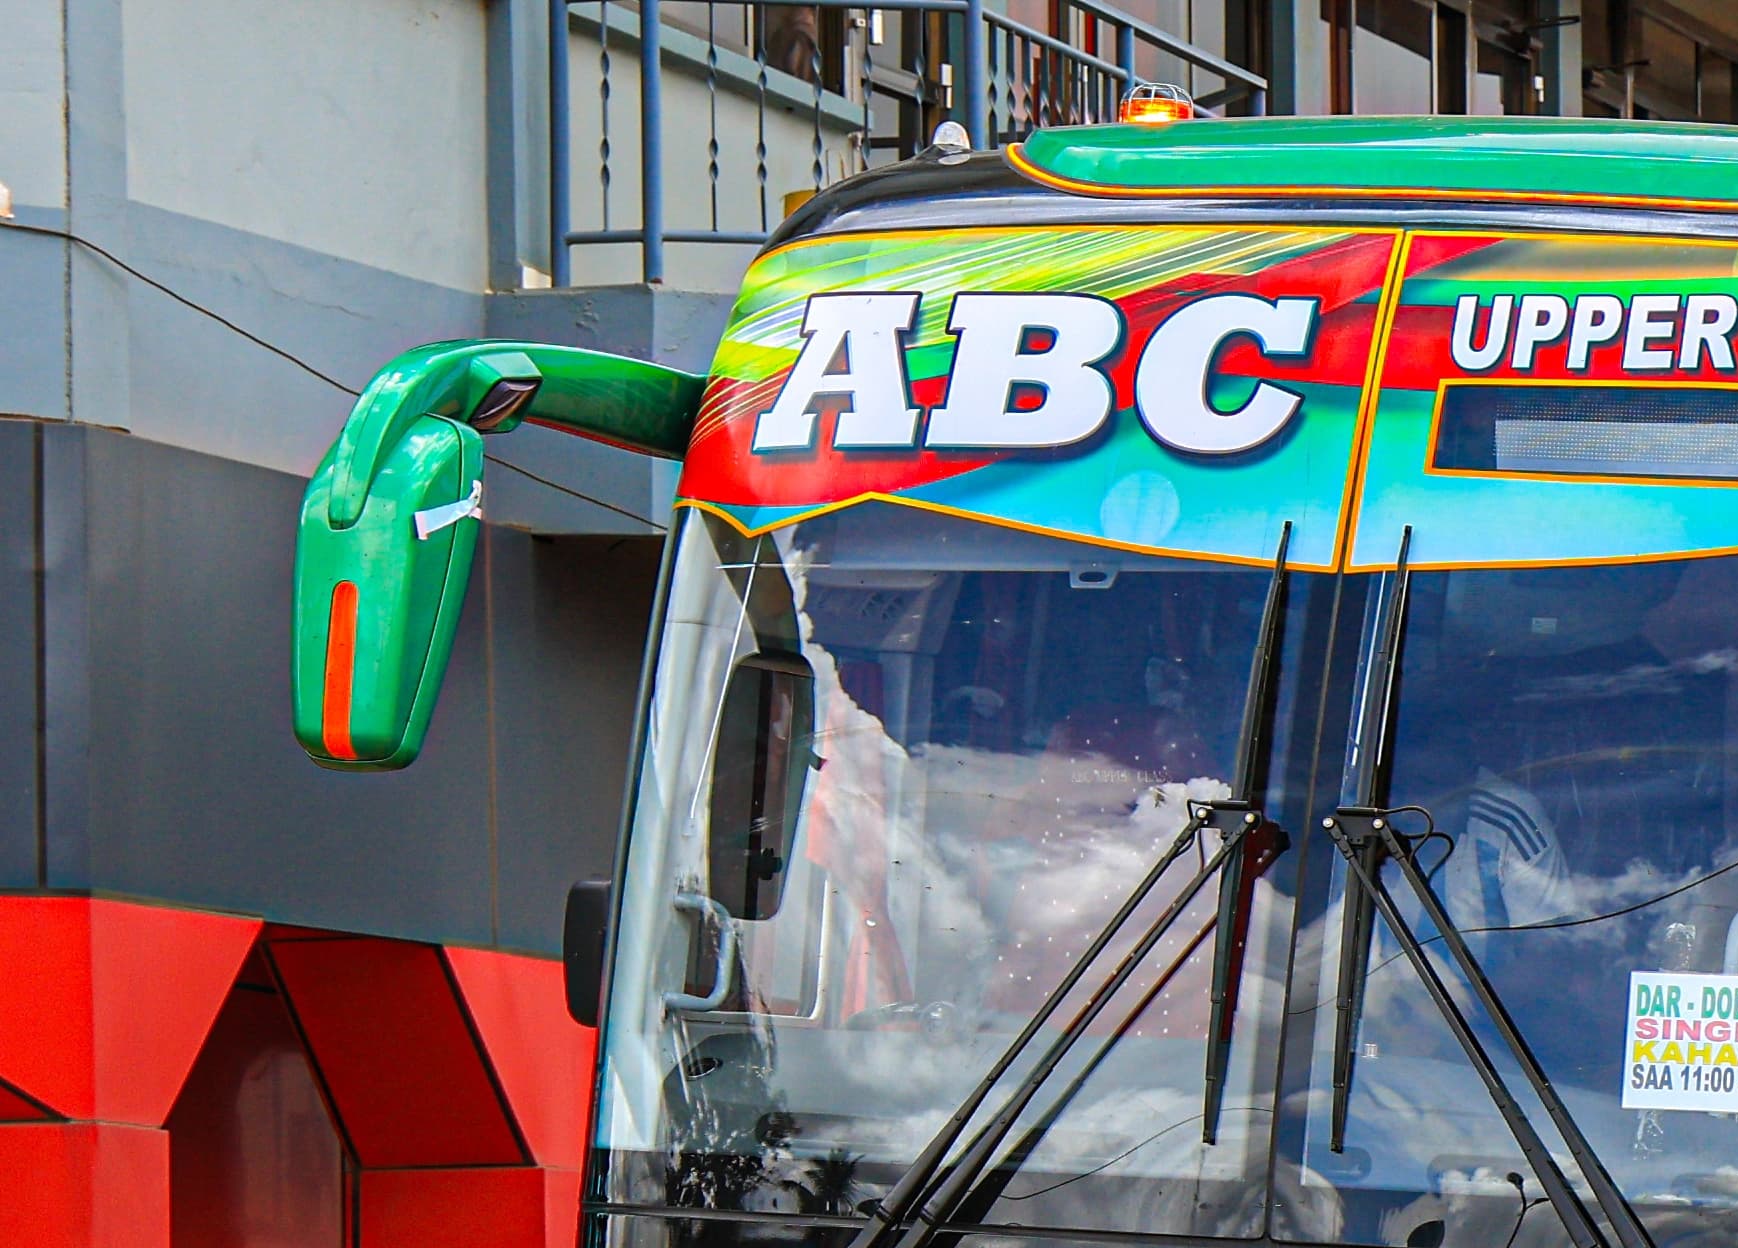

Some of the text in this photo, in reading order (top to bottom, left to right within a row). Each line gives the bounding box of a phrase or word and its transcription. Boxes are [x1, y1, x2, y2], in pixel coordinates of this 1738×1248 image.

[752, 292, 1318, 456] ABC
[1635, 983, 1682, 1018] DAR
[1631, 1064, 1674, 1090] SAA
[1680, 1066, 1735, 1093] 11:00
